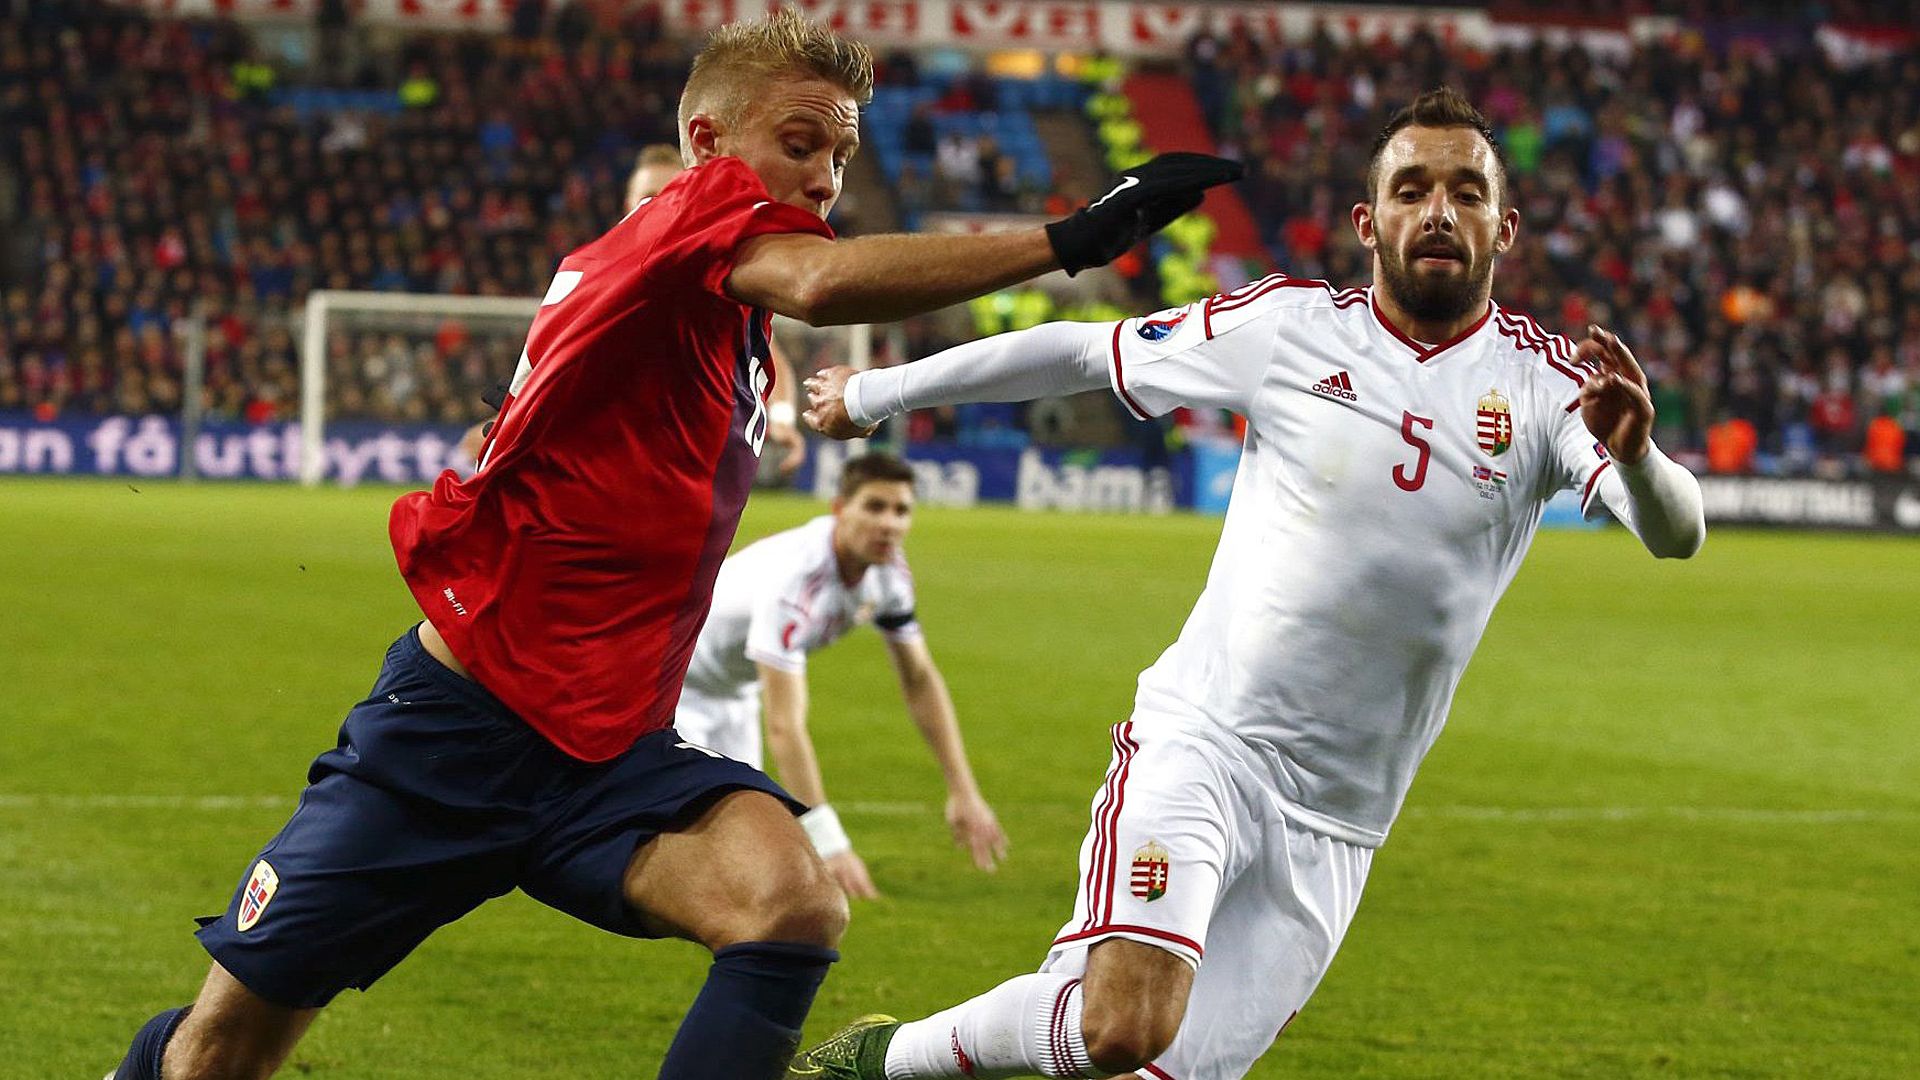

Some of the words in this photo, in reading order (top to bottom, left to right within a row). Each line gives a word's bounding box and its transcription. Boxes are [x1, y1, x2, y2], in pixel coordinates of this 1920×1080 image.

[1312, 380, 1358, 402] adidas
[86, 414, 177, 475] få
[1392, 410, 1434, 492] 5
[1017, 447, 1173, 515] bama
